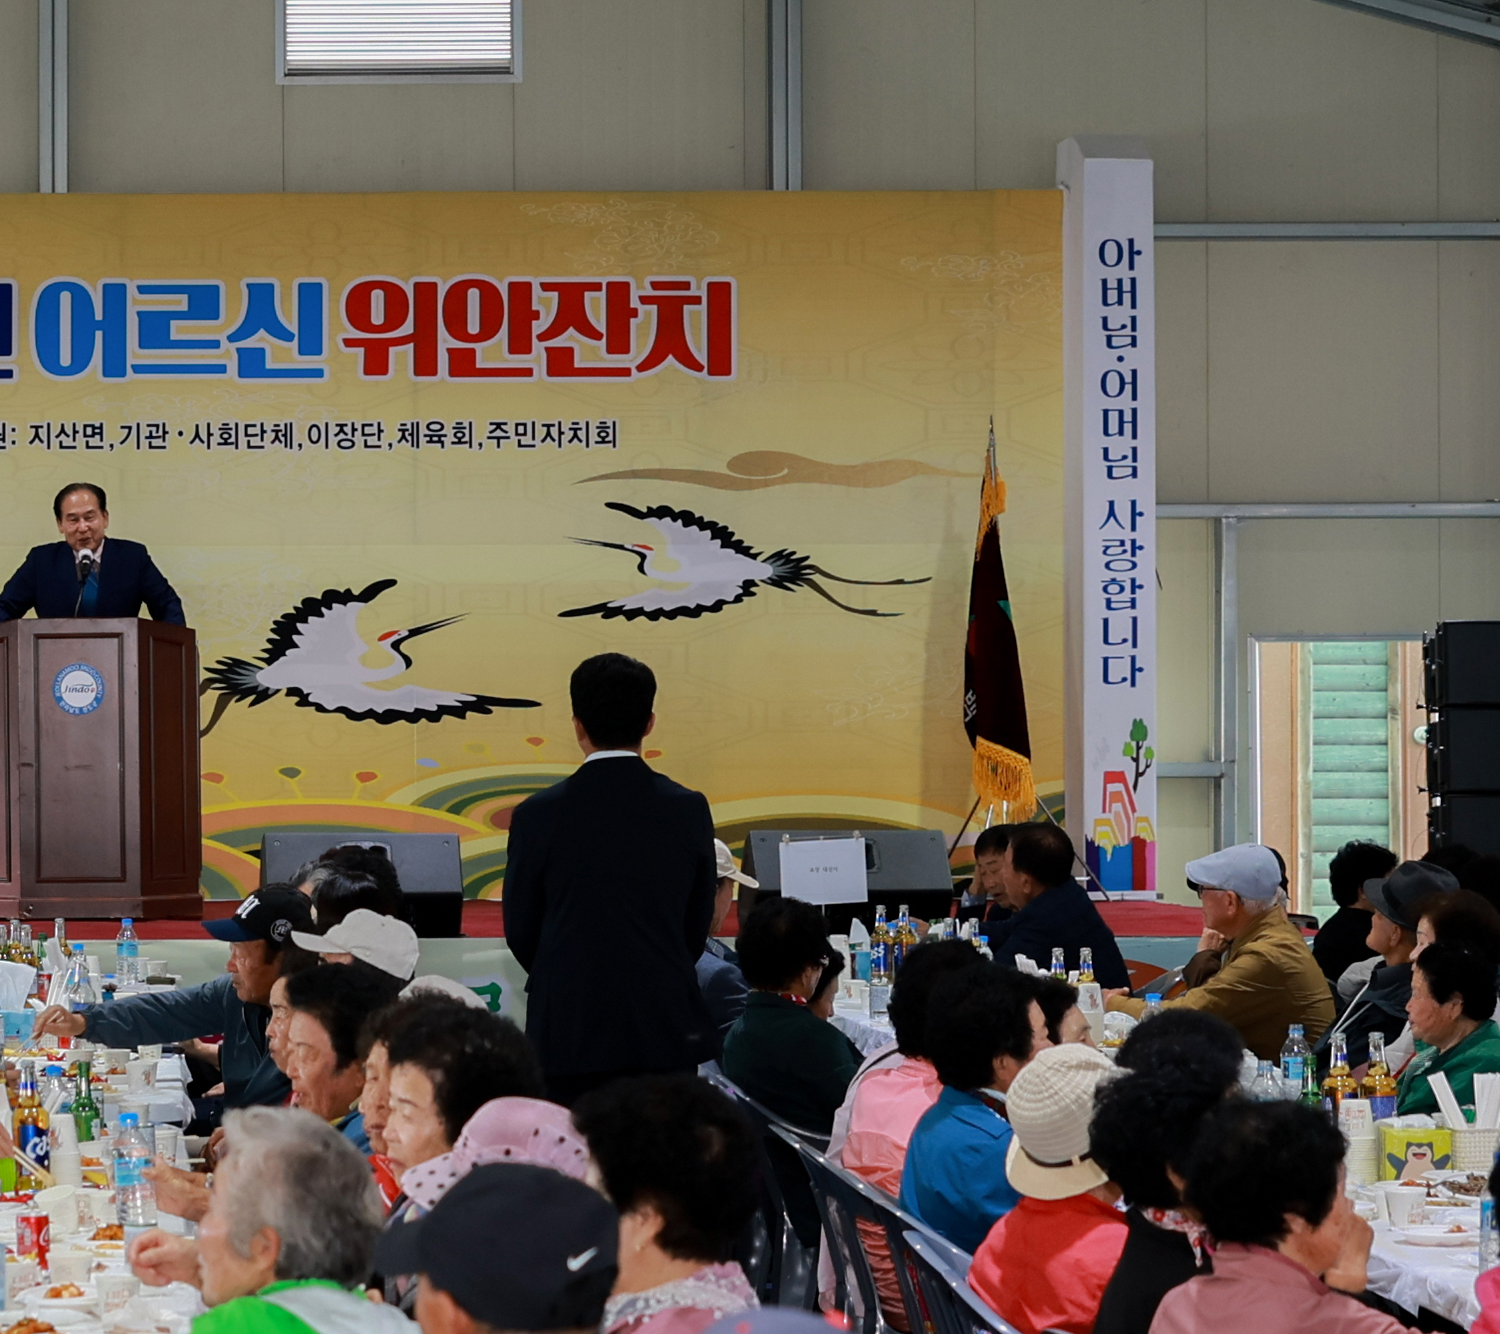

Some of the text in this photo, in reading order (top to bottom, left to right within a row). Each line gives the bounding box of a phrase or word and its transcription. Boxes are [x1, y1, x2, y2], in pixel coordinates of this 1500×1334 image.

[33, 281, 325, 379] 어르신
[340, 278, 733, 378] 위안잔치
[1098, 237, 1146, 689] 아버님·어머님 사랑합니다
